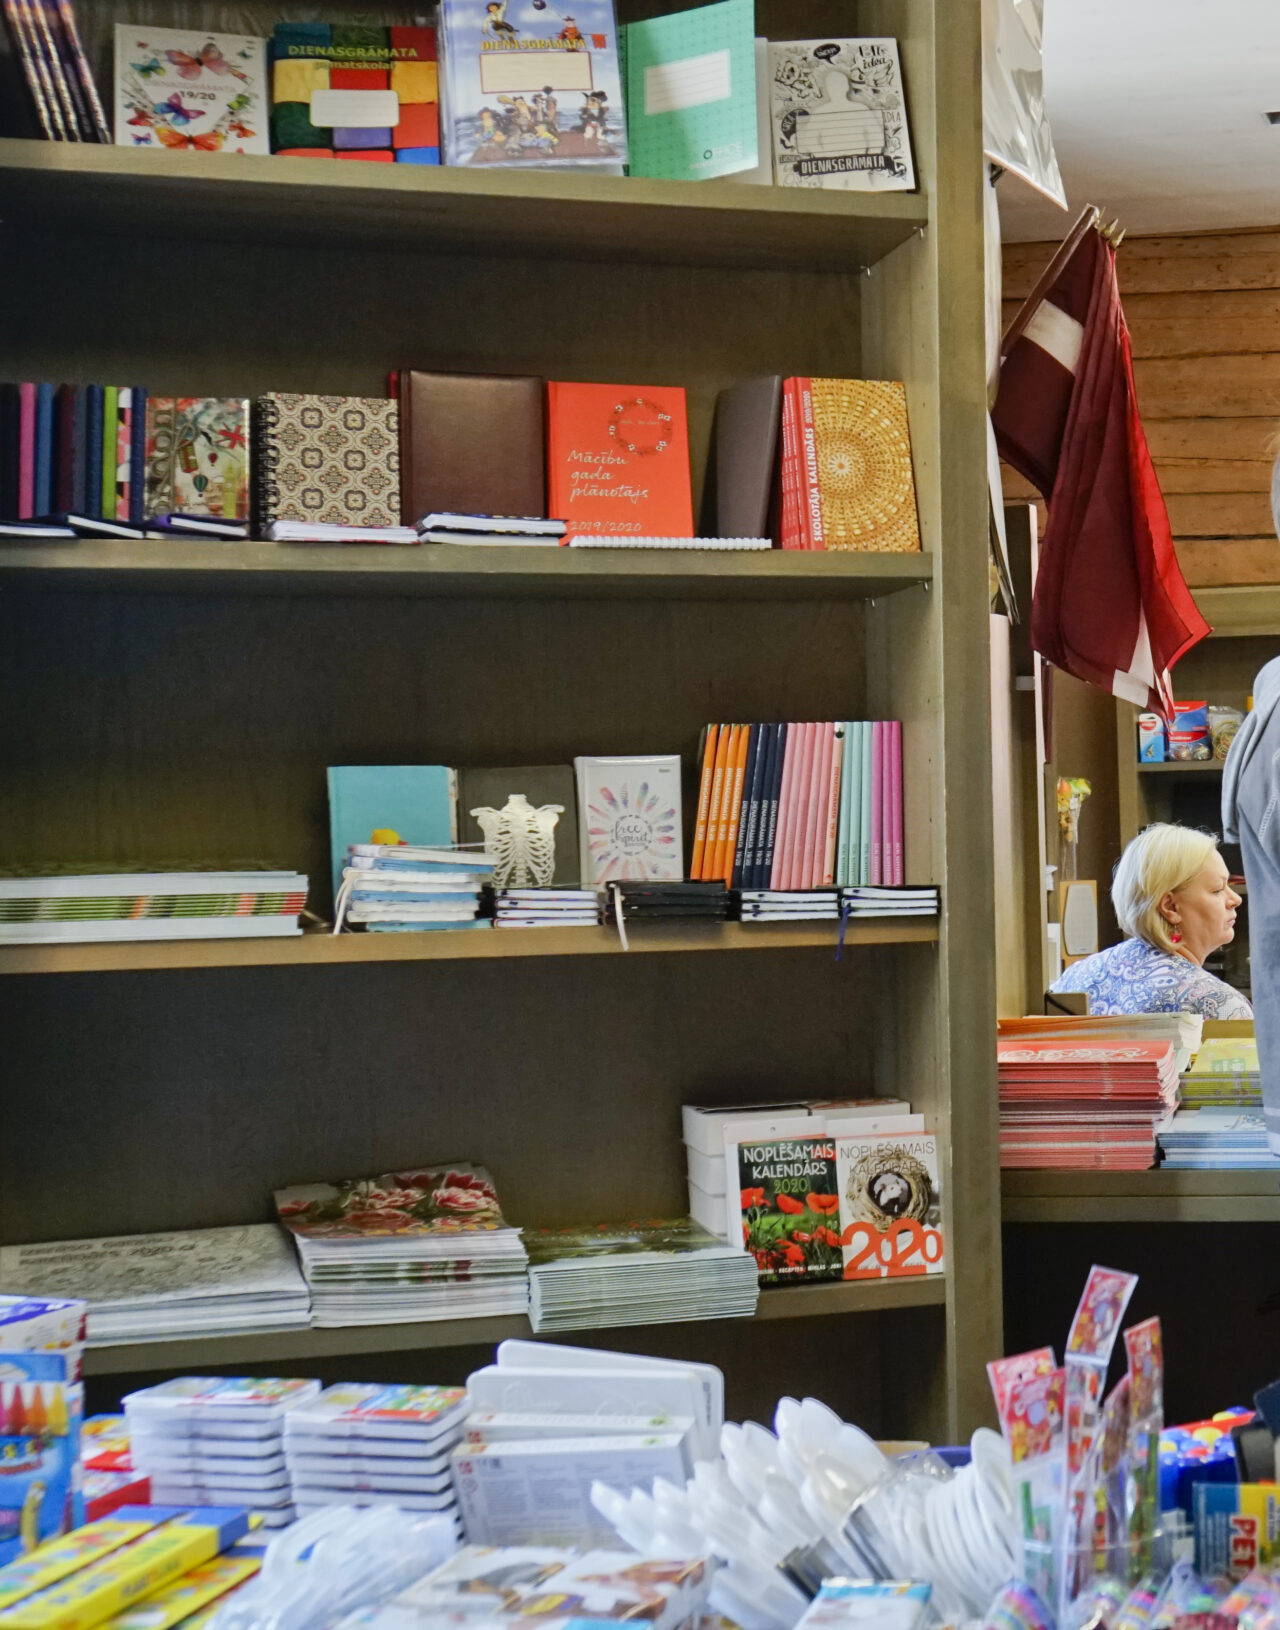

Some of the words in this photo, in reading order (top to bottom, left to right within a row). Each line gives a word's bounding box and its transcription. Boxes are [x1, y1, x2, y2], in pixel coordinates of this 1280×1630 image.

[288, 45, 418, 59] DIENASGRĀMATA
[179, 90, 216, 100] 19/20
[801, 155, 885, 174] DIENASGRĀMATA
[567, 450, 628, 466] Mācību
[804, 428, 818, 485] KALENDĀRS
[571, 467, 614, 481] gada
[570, 484, 648, 504] plānotājs
[809, 487, 824, 542] SKOLOTĀJA
[570, 520, 642, 533] 2019/2020
[743, 1143, 834, 1163] NOPLĒŠAMAIS
[840, 1141, 935, 1160] NOPLĒŠAMAIS
[752, 1160, 827, 1179] KALENDĀRS
[773, 1178, 808, 1195] 2020
[839, 1218, 943, 1280] 2020
